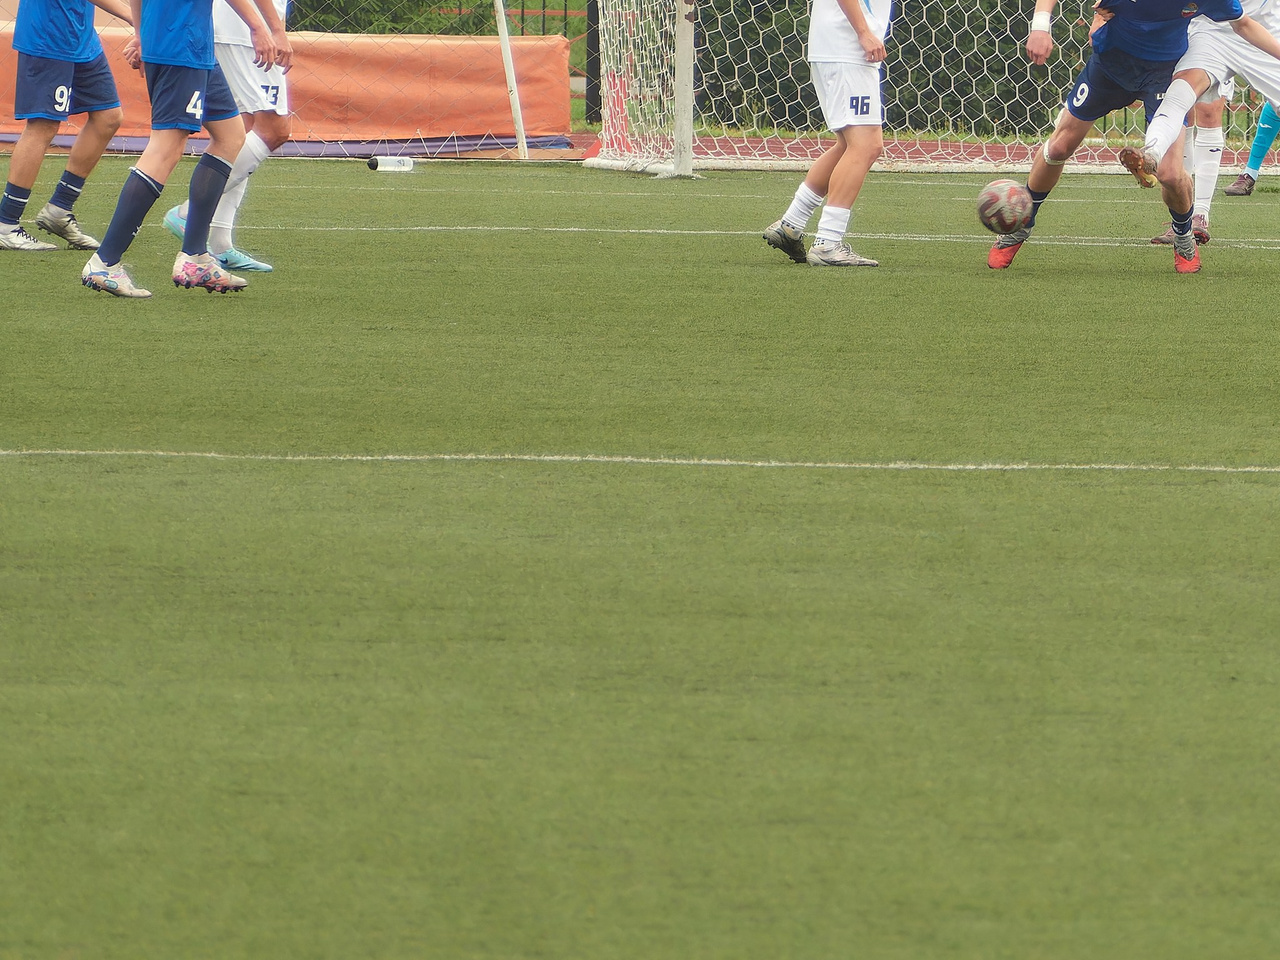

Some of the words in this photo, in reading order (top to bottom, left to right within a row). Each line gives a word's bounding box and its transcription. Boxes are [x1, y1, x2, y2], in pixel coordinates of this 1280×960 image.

[186, 90, 203, 119] 4
[261, 85, 279, 105] 73
[850, 96, 870, 115] 96
[1073, 83, 1089, 108] 9
